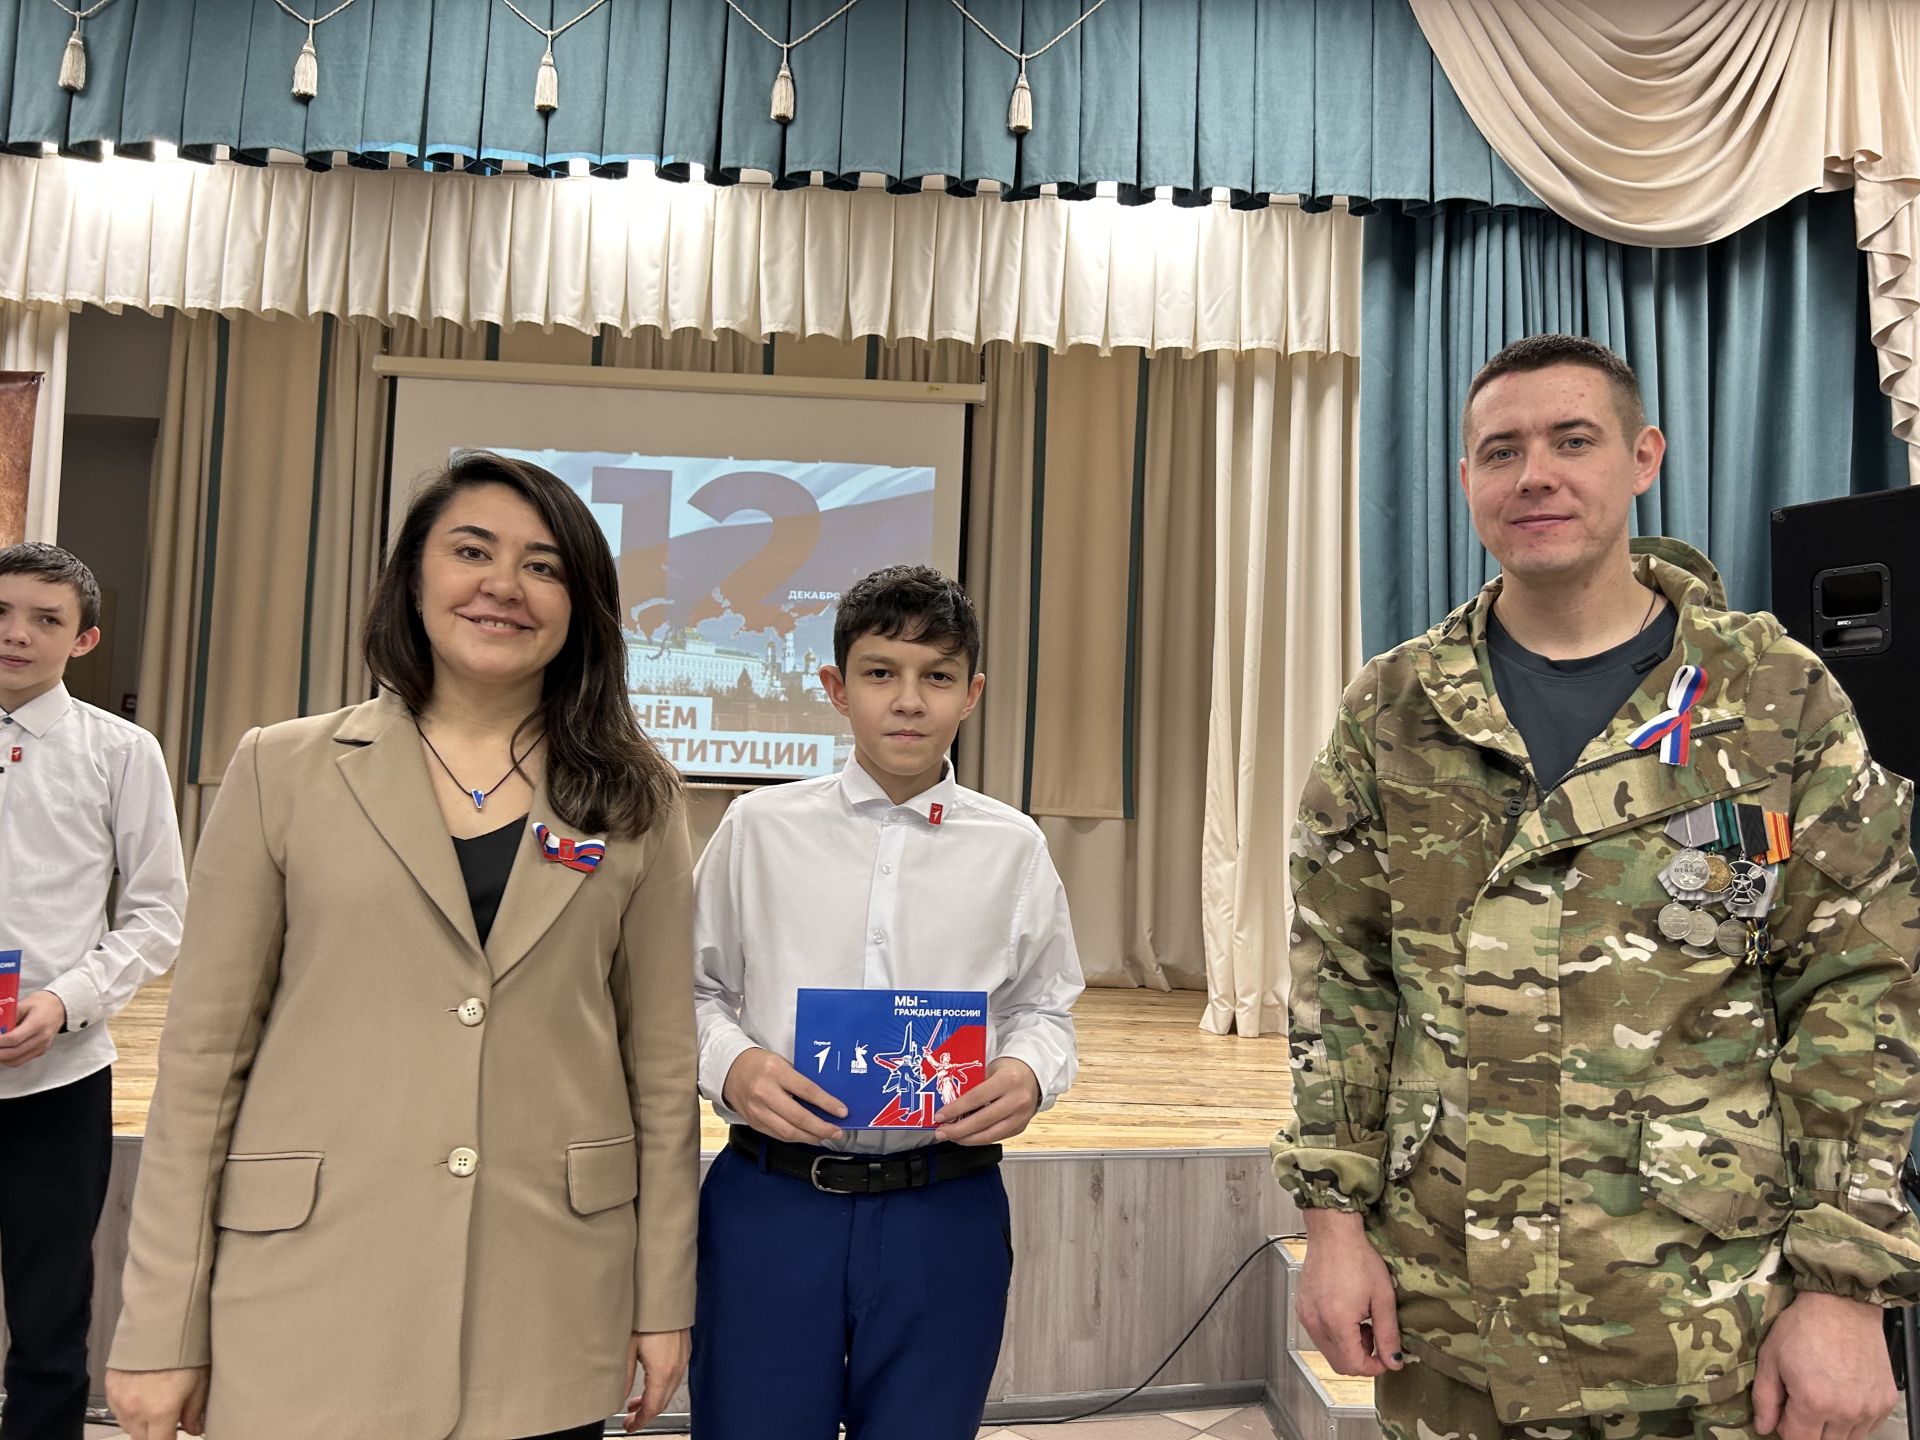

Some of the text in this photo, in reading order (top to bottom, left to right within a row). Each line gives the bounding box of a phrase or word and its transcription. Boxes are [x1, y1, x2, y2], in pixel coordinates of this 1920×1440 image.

[591, 466, 822, 638] 12
[788, 590, 841, 600] ДЕКАБРЯ
[632, 699, 697, 729] НЁМ
[894, 996, 918, 1007] МЫ
[894, 1009, 941, 1017] ГРАЖДАНЕ
